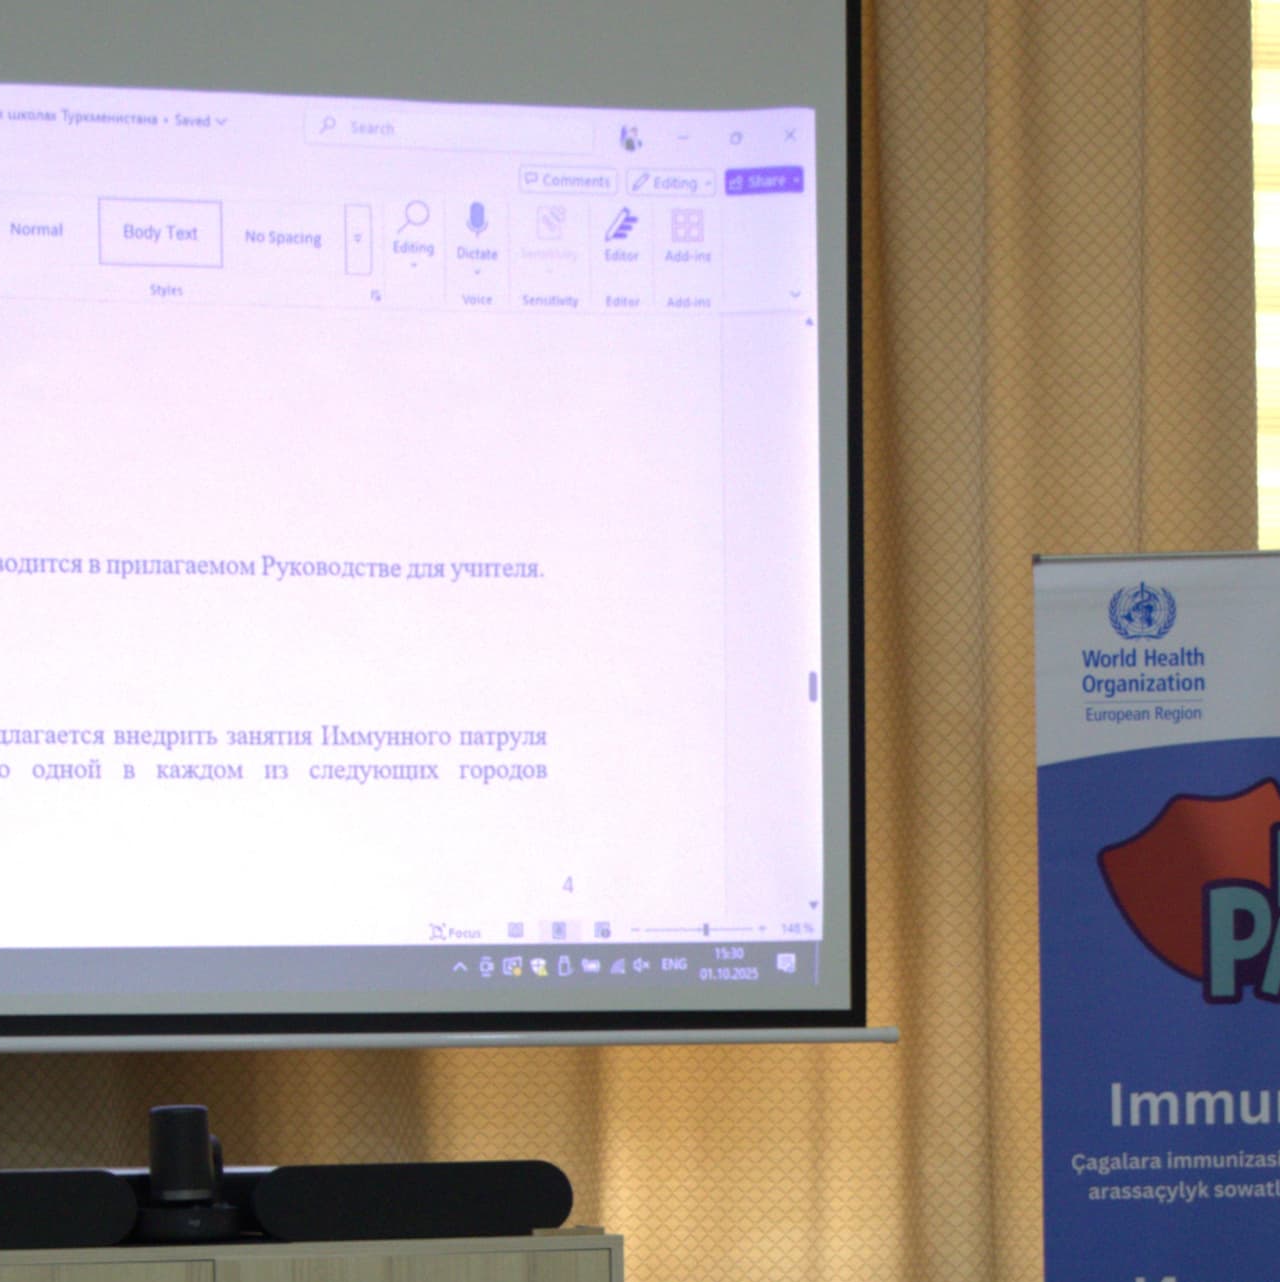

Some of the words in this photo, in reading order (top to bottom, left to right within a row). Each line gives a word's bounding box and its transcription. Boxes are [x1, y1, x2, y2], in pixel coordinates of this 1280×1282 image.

[7, 109, 57, 123] школах
[61, 108, 158, 127] Туркменистана
[174, 112, 211, 128] Saved
[350, 118, 395, 137] Search
[542, 172, 611, 188] Comments
[653, 176, 698, 192] Editing
[748, 174, 787, 187] Share
[9, 221, 64, 238] Normal
[122, 222, 162, 244] Body
[166, 224, 199, 242] Text
[244, 229, 266, 244] No
[269, 230, 322, 249] Spacing
[392, 239, 435, 258] Editing
[456, 245, 499, 262] Dictate
[604, 249, 639, 263] Editor
[665, 249, 712, 263] Add-ins
[149, 282, 183, 297] Styles
[461, 292, 493, 306] Voice
[88, 557, 101, 574] в
[107, 556, 255, 578] прилагаемом
[262, 555, 402, 581] Руководстве
[407, 559, 445, 580] для
[451, 559, 545, 581] учителя.
[1082, 647, 1137, 668] World
[1144, 646, 1205, 667] Health
[1082, 672, 1205, 698] Organization
[1085, 706, 1150, 724] European
[1155, 705, 1202, 724] Region
[113, 728, 218, 747] внедрить
[226, 728, 312, 746] занятия
[320, 725, 452, 749] Иммунного
[460, 728, 547, 749] патруля
[32, 759, 102, 781] одной
[124, 763, 136, 778] в
[156, 762, 244, 780] каждом
[264, 763, 290, 779] из
[309, 763, 439, 783] следующих
[460, 763, 548, 783] городов
[561, 875, 574, 893] 4
[448, 926, 482, 940] Focus
[661, 958, 688, 971] ENG
[1071, 1153, 1162, 1175] Çagalara
[1088, 1180, 1210, 1203] arassaçylyk
